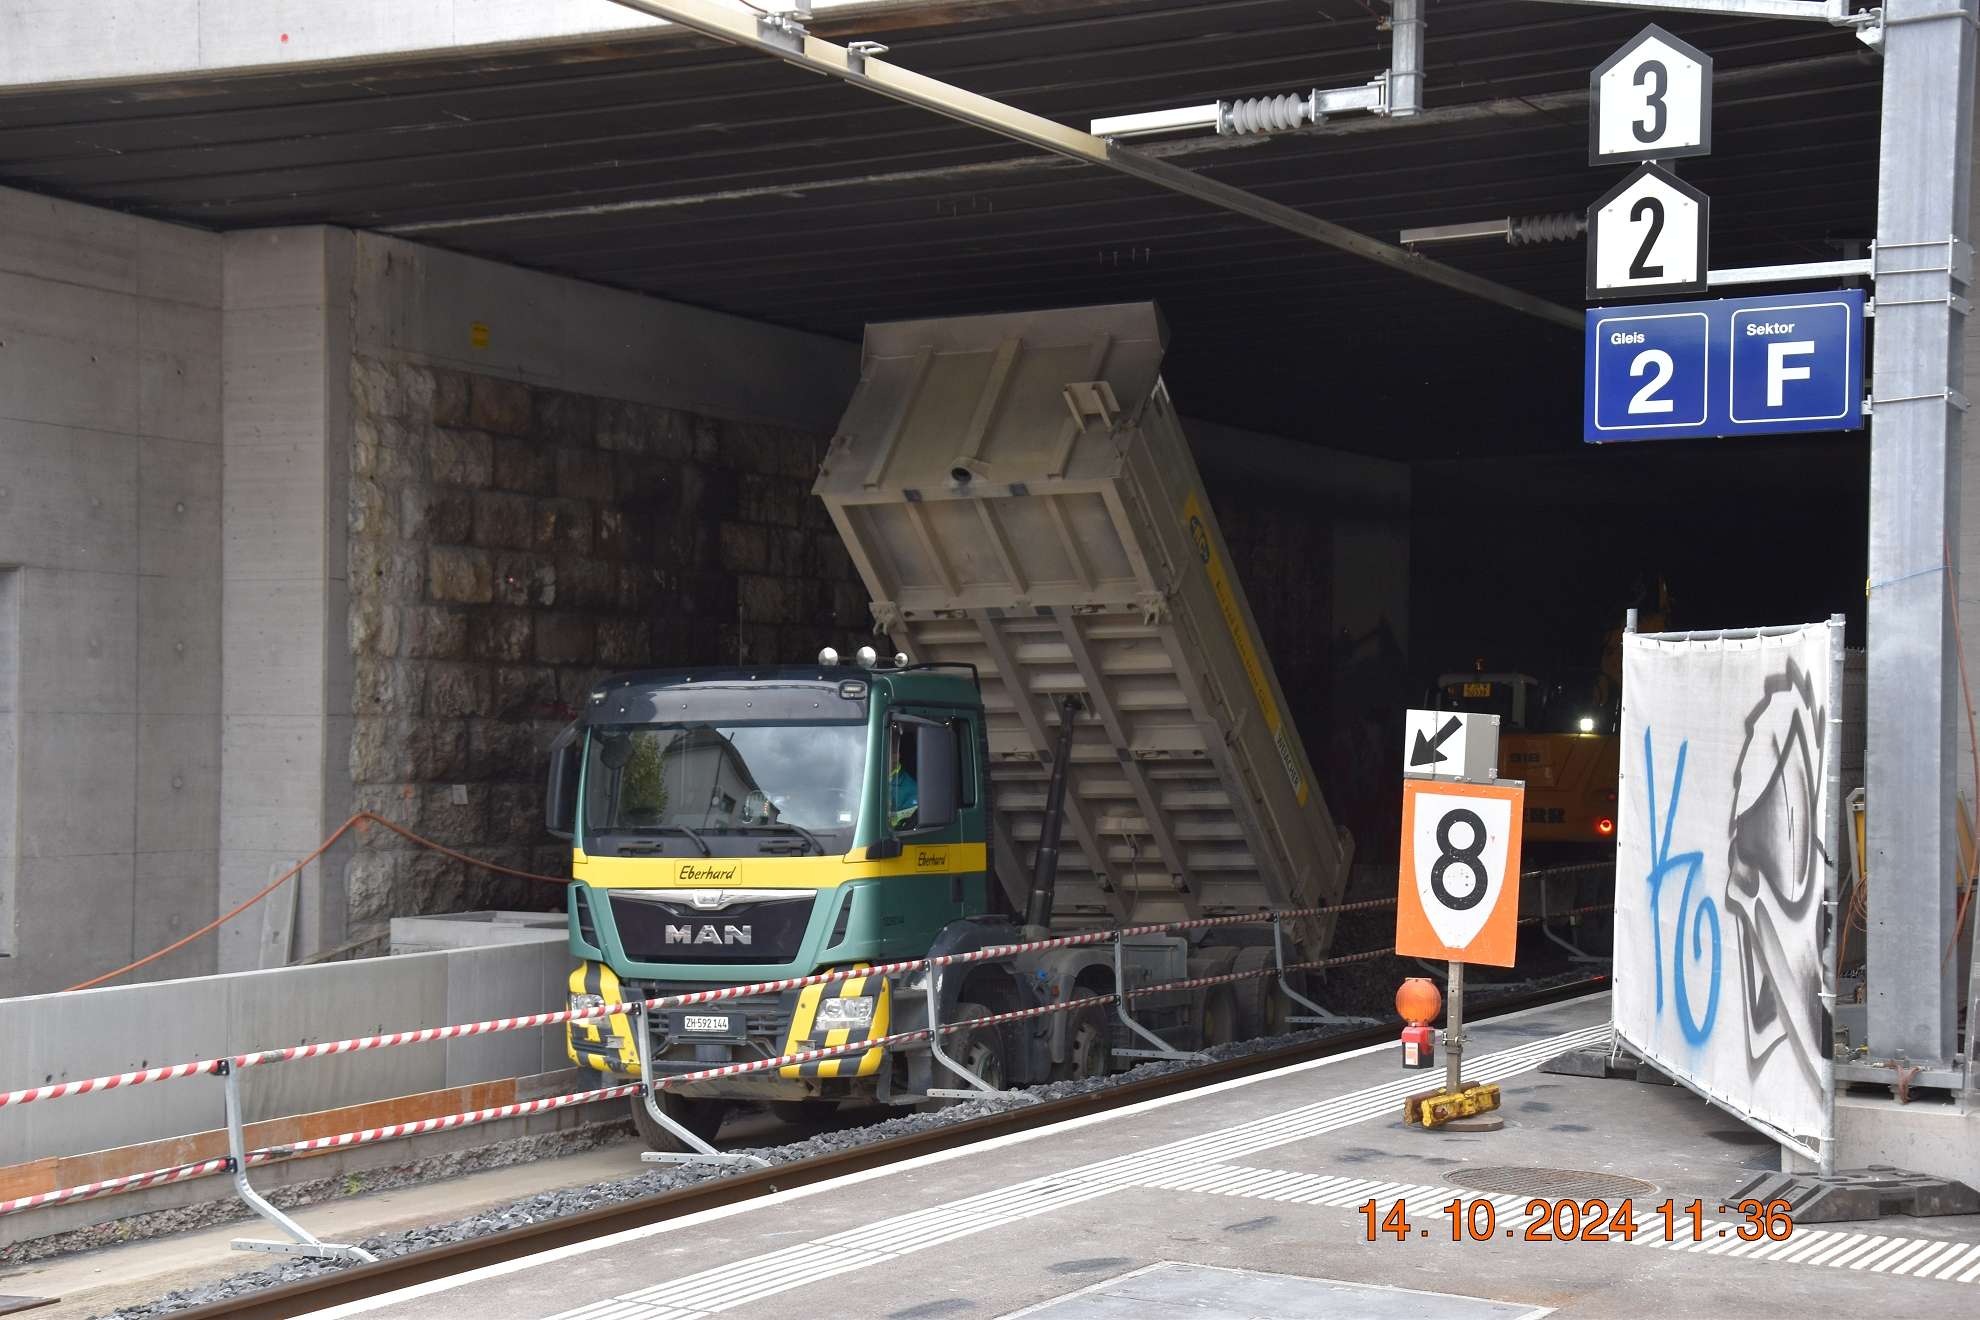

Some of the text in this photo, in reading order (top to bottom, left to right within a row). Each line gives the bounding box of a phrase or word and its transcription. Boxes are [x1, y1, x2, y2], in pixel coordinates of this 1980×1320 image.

[1631, 59, 1668, 144] 3
[1628, 196, 1666, 280] 2
[1610, 330, 1646, 346] Gleis
[1746, 320, 1796, 337] Sektor
[1627, 349, 1674, 414] 2
[1765, 340, 1816, 407] F
[679, 864, 736, 881] Eberhard
[1430, 808, 1488, 911] 8
[665, 924, 752, 945] MAN
